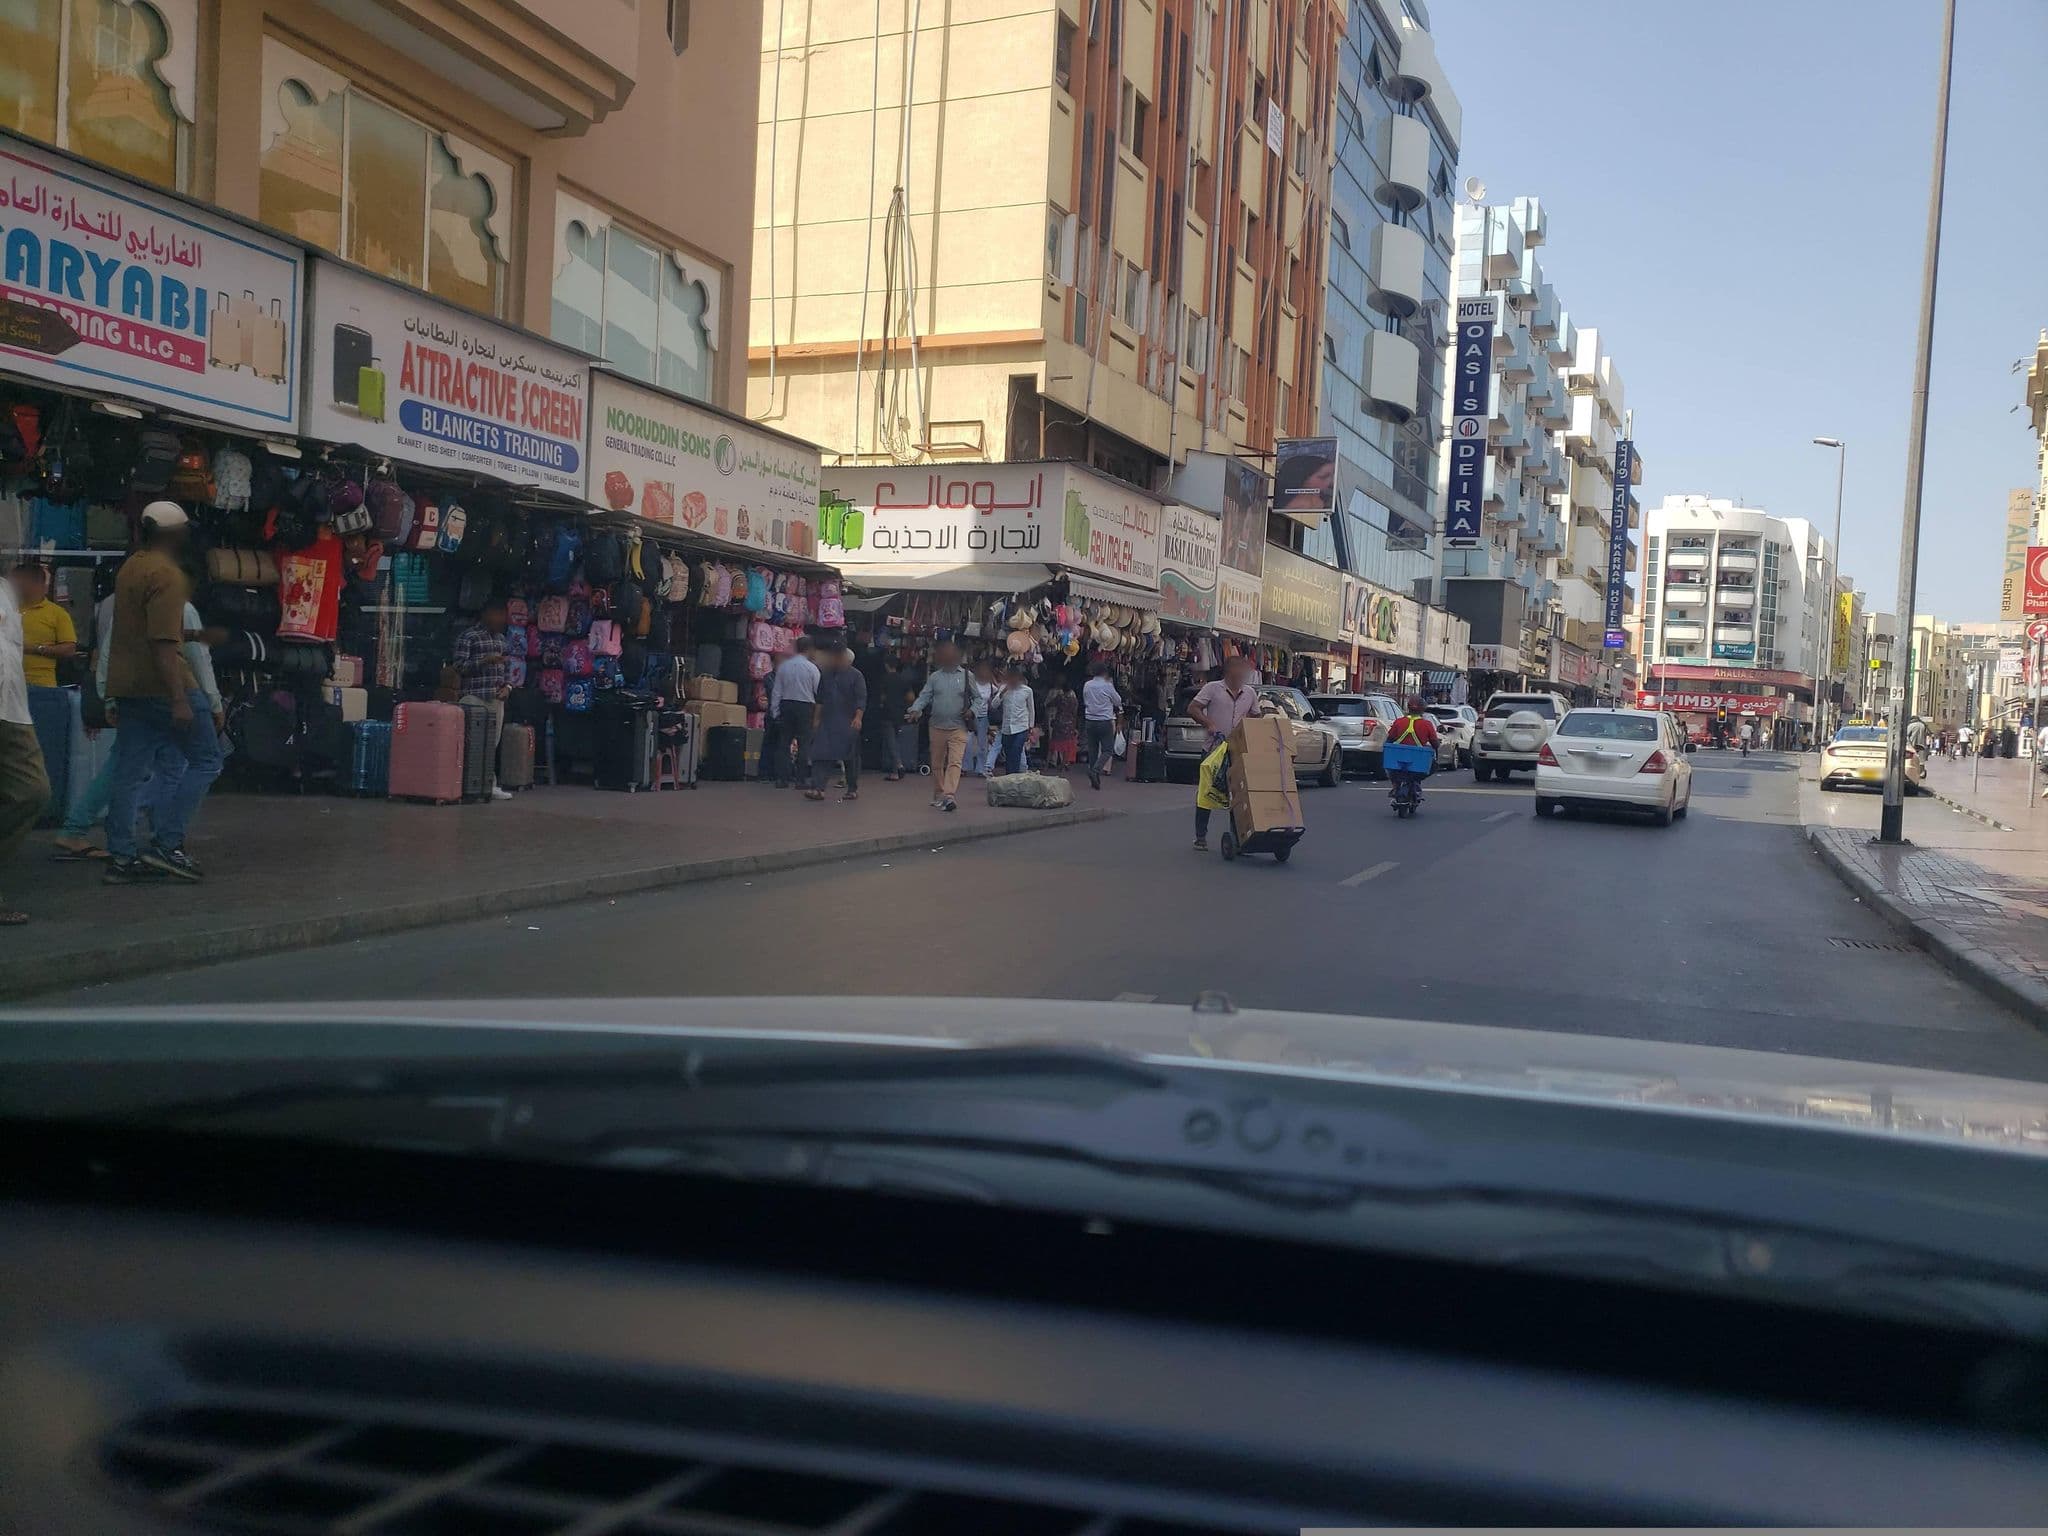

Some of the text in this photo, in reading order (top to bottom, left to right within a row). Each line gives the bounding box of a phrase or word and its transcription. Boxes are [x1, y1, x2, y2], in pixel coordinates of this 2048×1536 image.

[51, 194, 122, 241] للتجارة
[125, 225, 202, 269] الفاريابي
[0, 225, 207, 337] ARYABI
[1458, 302, 1493, 316] HOTEL
[1462, 325, 1485, 411] OASIS
[400, 340, 583, 442] ATTRACTIVE SCREEN
[422, 407, 563, 467] BLANKETS TRADING
[605, 435, 631, 454] GENERAL
[631, 441, 655, 461] TRADING
[606, 406, 711, 460] NOORUDDIN SONS
[397, 436, 422, 450] BLANKET
[428, 443, 439, 454] BED
[439, 445, 457, 458] SHEET
[461, 452, 493, 467] COMFORTER
[497, 461, 518, 473] TOWELS
[521, 466, 539, 478] PILLOW
[1453, 445, 1476, 531] DEIRA
[968, 524, 1041, 554] لتجارة
[1164, 534, 1186, 563] WASAT
[1612, 543, 1622, 584] KARNAK
[1272, 585, 1300, 617] BEAUTY
[1610, 591, 1619, 624] HOTEL
[2001, 578, 2012, 612] CENTER
[1714, 668, 1746, 679] AHALIA
[1891, 688, 1904, 699] 91
